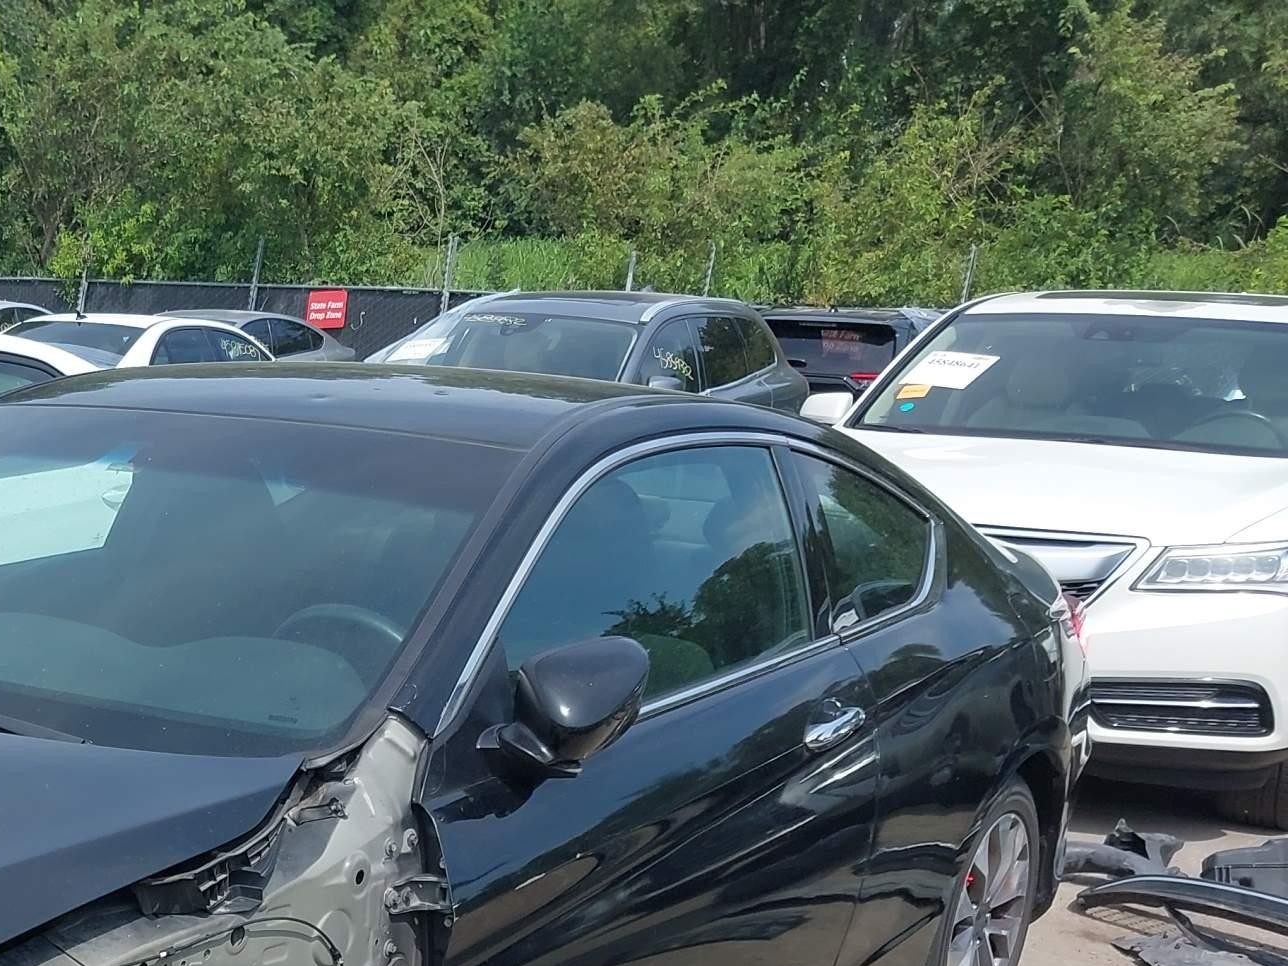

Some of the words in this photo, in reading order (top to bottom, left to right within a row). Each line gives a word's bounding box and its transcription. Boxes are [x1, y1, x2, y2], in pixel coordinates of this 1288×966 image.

[310, 302, 327, 310] State
[327, 300, 344, 308] Farm
[309, 312, 325, 320] Drop
[326, 311, 342, 319] Zone
